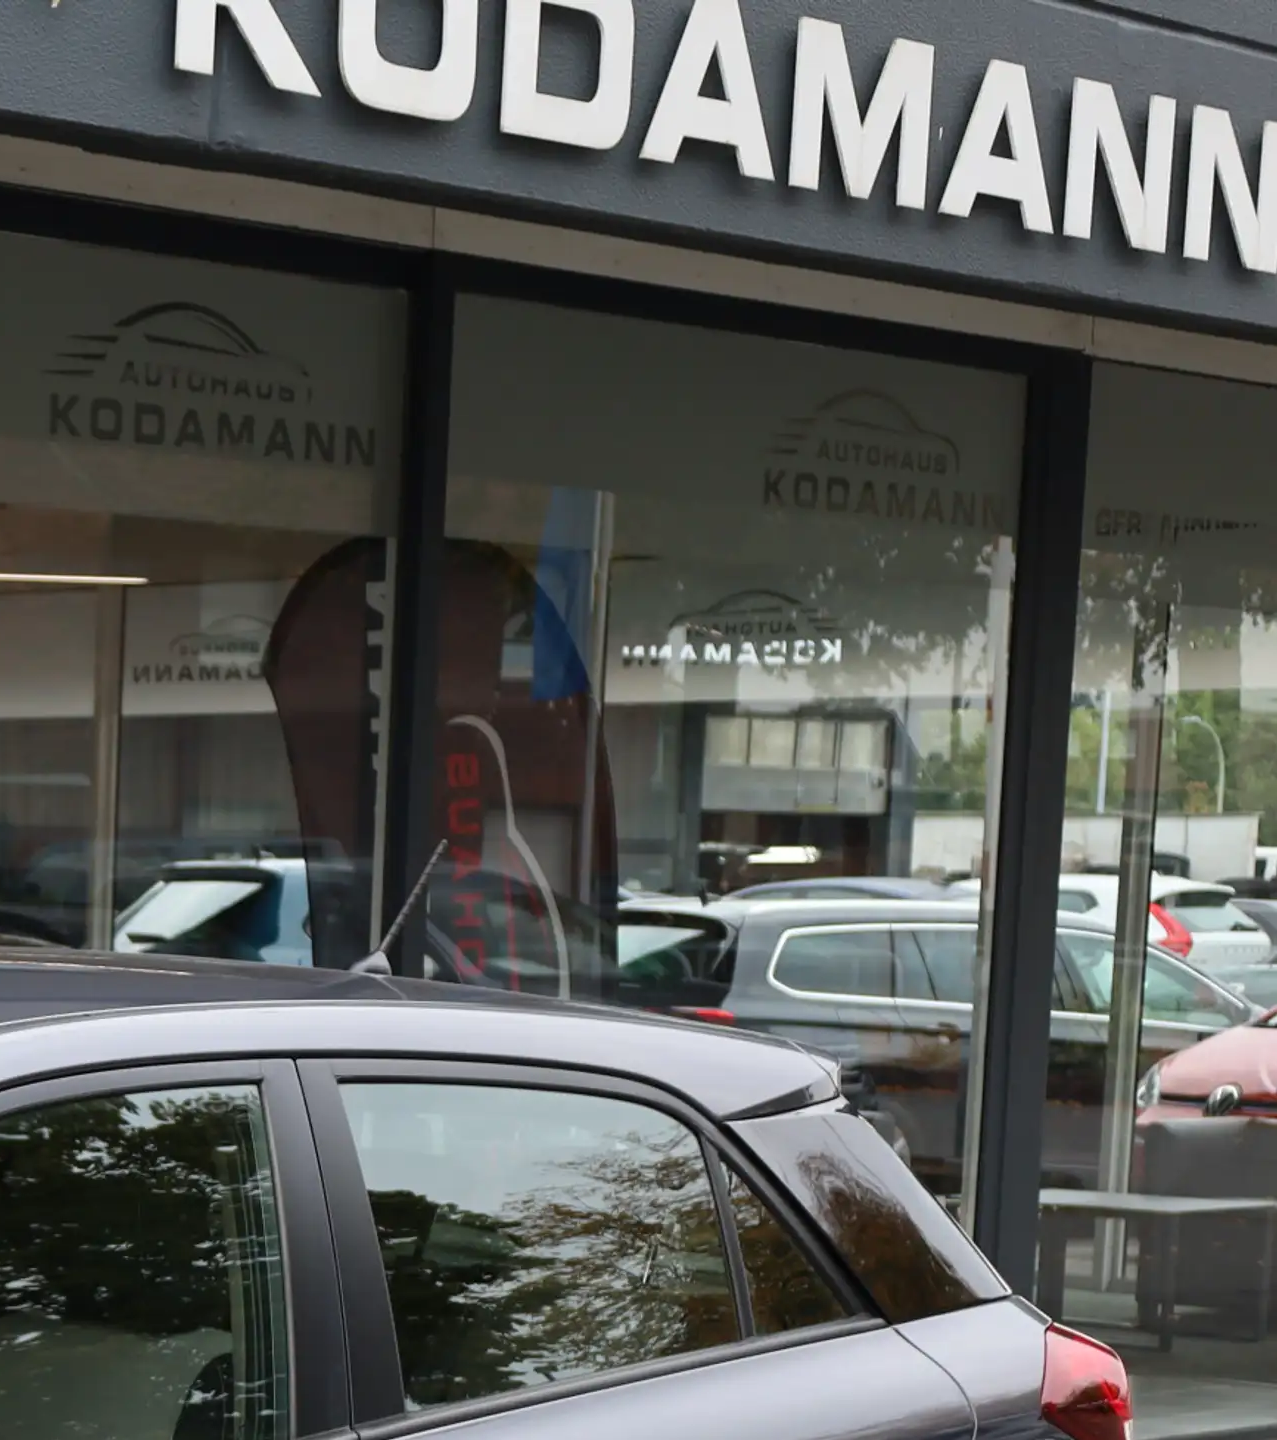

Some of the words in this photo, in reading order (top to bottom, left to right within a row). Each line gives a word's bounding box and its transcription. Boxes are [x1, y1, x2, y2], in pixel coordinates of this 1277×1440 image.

[119, 359, 296, 404] AUTOHAUS
[48, 392, 376, 467] KODAMANN
[816, 438, 949, 475] AUTOHAUS
[762, 466, 1005, 530] KODAMANN
